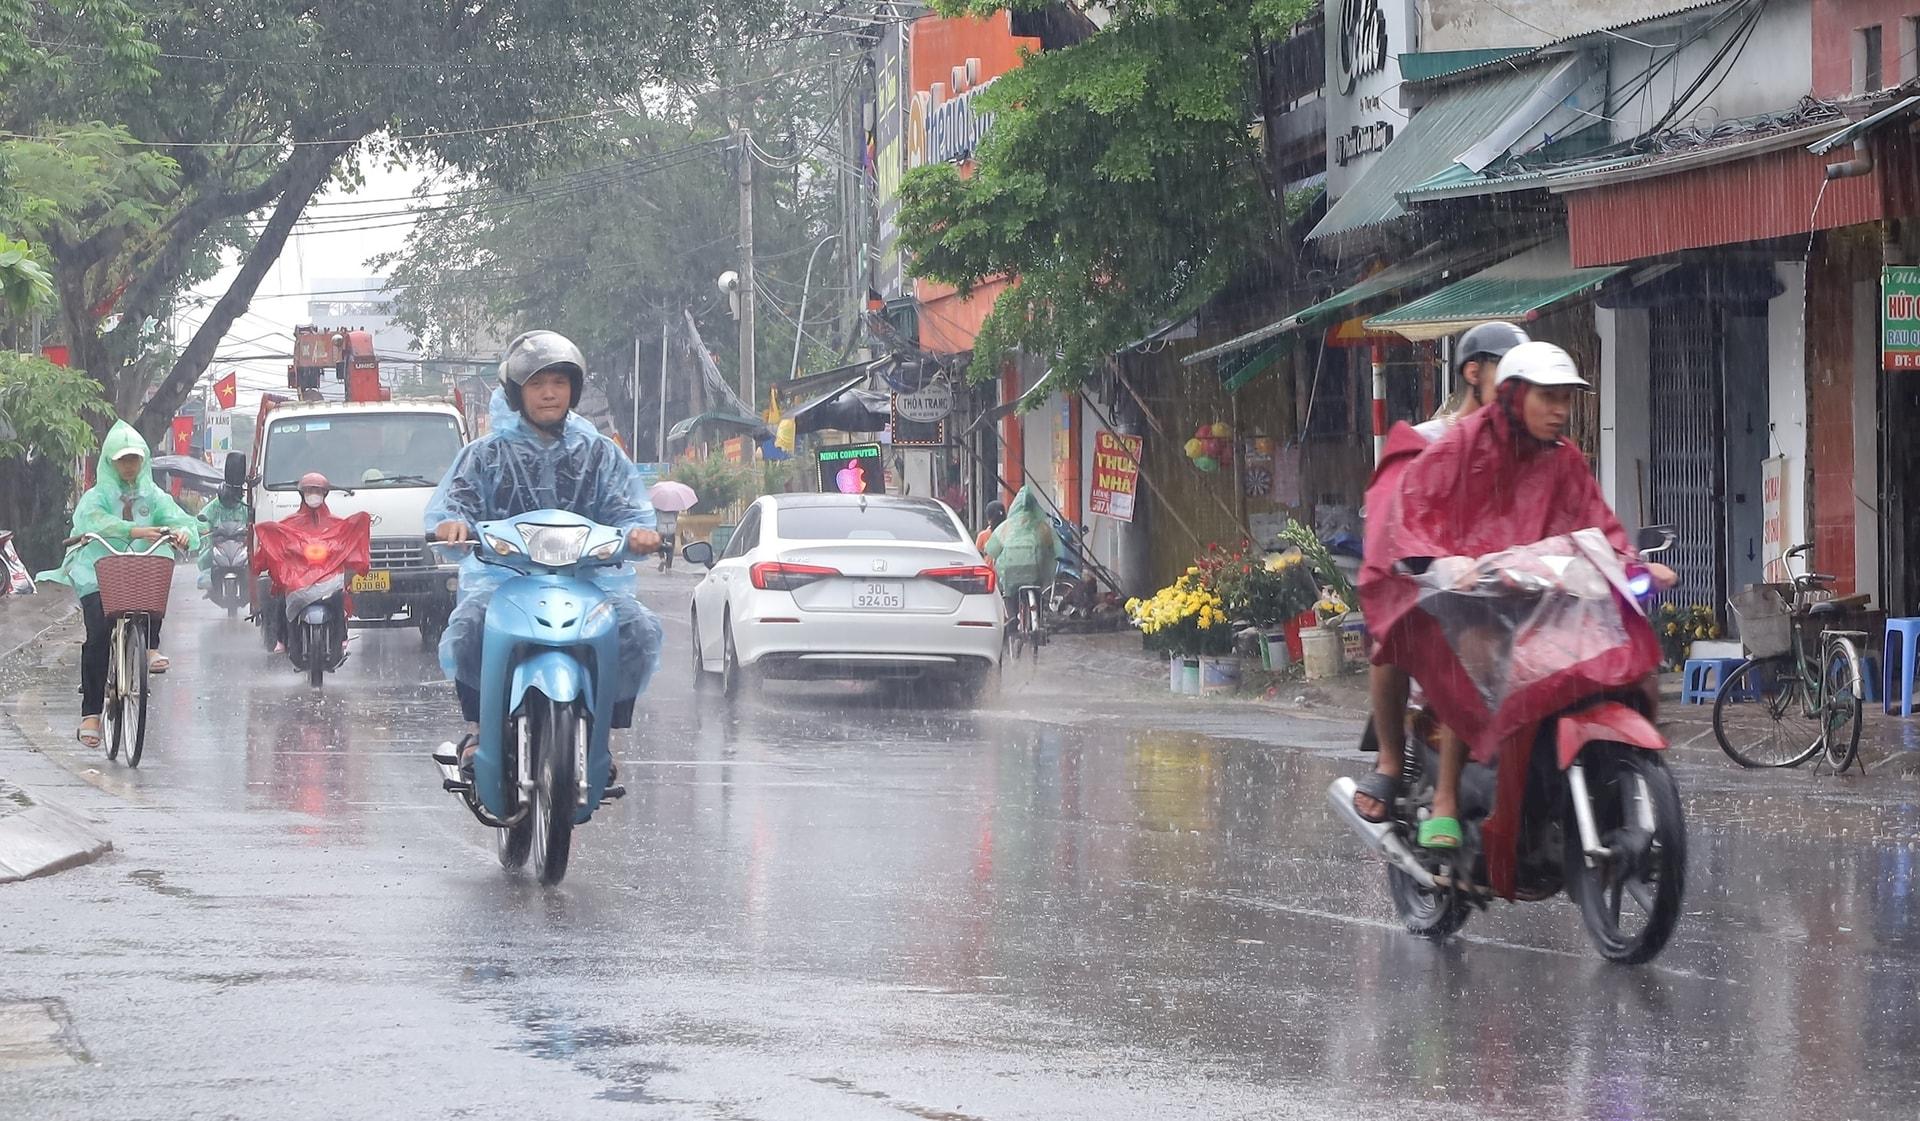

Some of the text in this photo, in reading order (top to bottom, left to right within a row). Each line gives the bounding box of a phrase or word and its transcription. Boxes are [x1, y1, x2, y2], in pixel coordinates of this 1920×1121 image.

[1887, 330, 1909, 345] RAU
[840, 448, 878, 459] COMPUTER
[867, 584, 889, 595] 30L
[858, 595, 899, 607] 924.05
